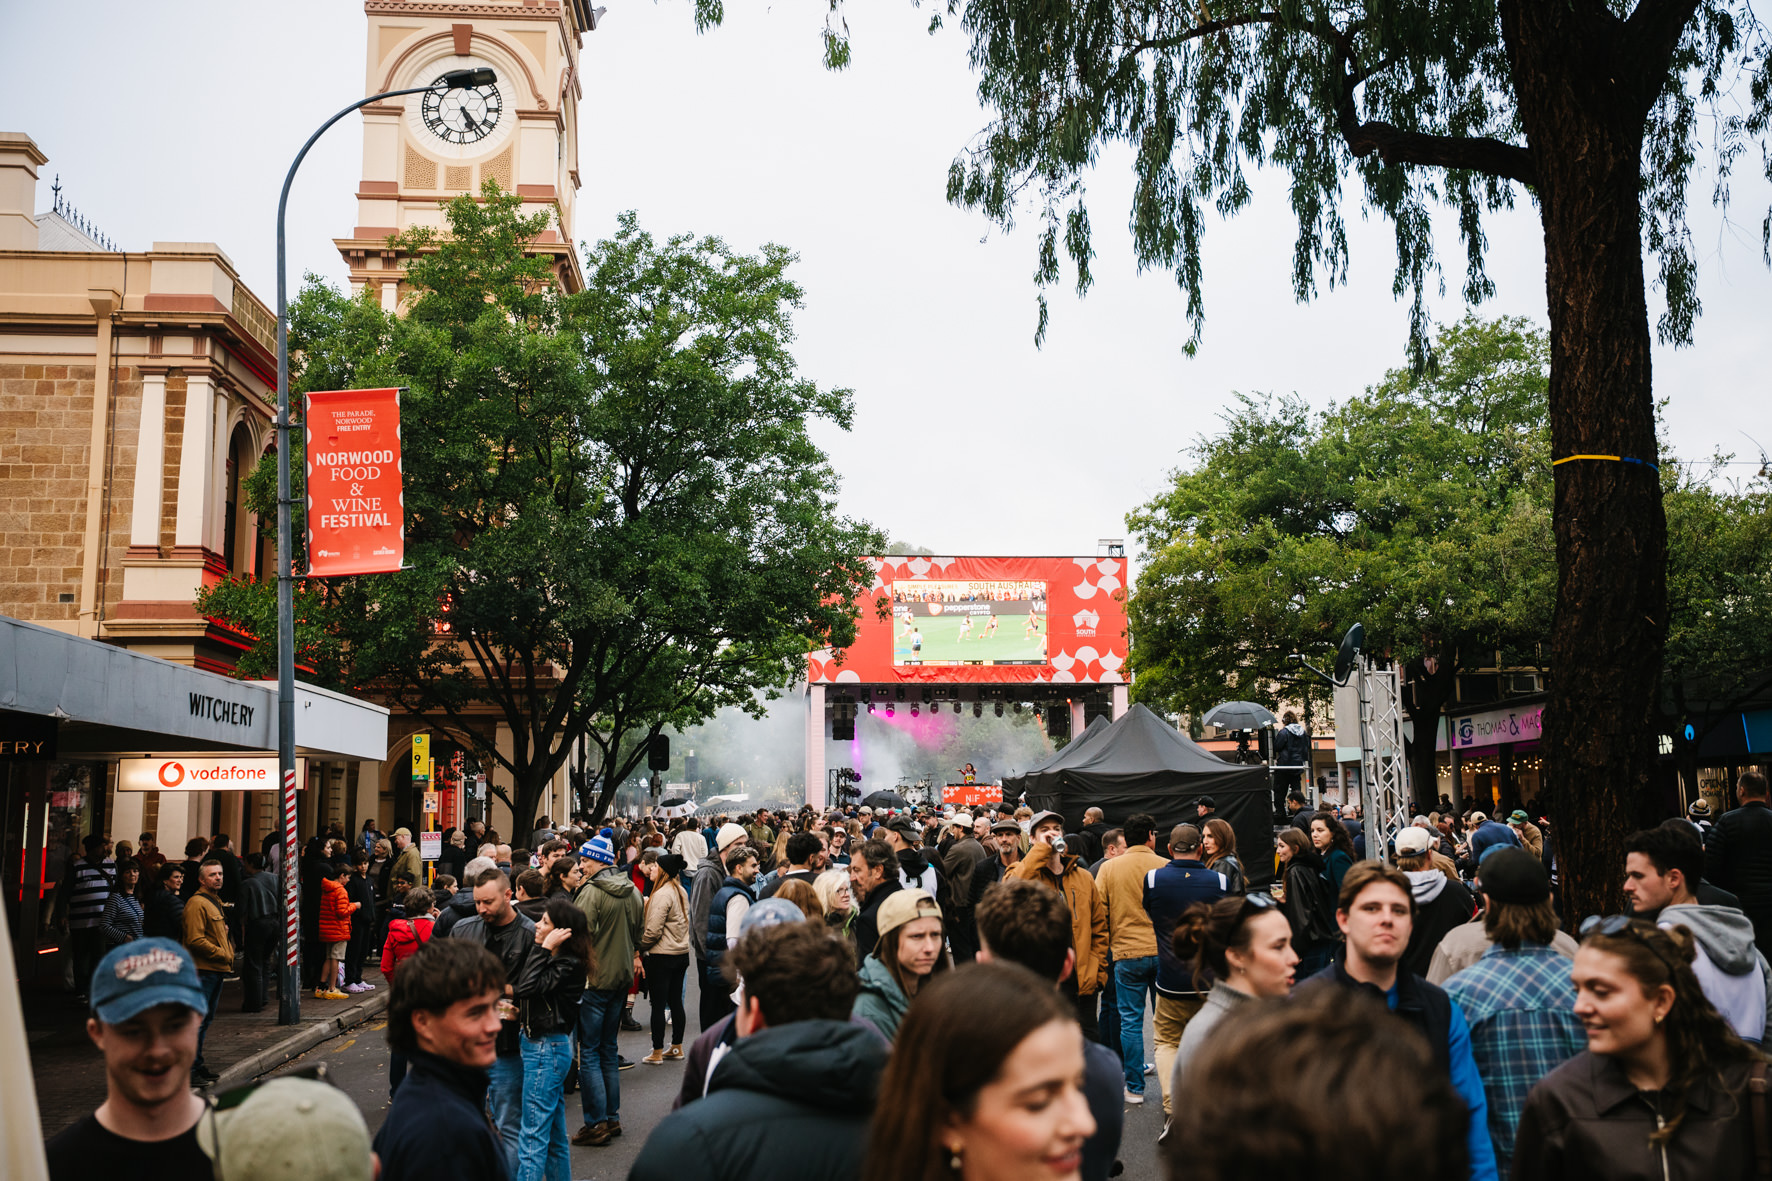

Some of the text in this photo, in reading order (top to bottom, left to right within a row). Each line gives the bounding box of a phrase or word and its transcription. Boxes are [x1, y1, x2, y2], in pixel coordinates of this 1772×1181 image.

[352, 424, 371, 432] ENTRY
[316, 450, 394, 466] NORWOOD
[330, 466, 381, 481] FOOD
[350, 482, 364, 496] &
[331, 497, 382, 512] WINE
[321, 512, 391, 528] FESTIVAL
[968, 581, 1033, 590] SOUTH AUSTRAL
[943, 603, 991, 613] pepperstone
[189, 691, 255, 727] WITCHERY
[1476, 719, 1507, 737] THOMAS
[1509, 713, 1520, 736] &
[0, 741, 44, 754] ERY
[414, 754, 421, 765] 9
[190, 765, 266, 781] vodafone
